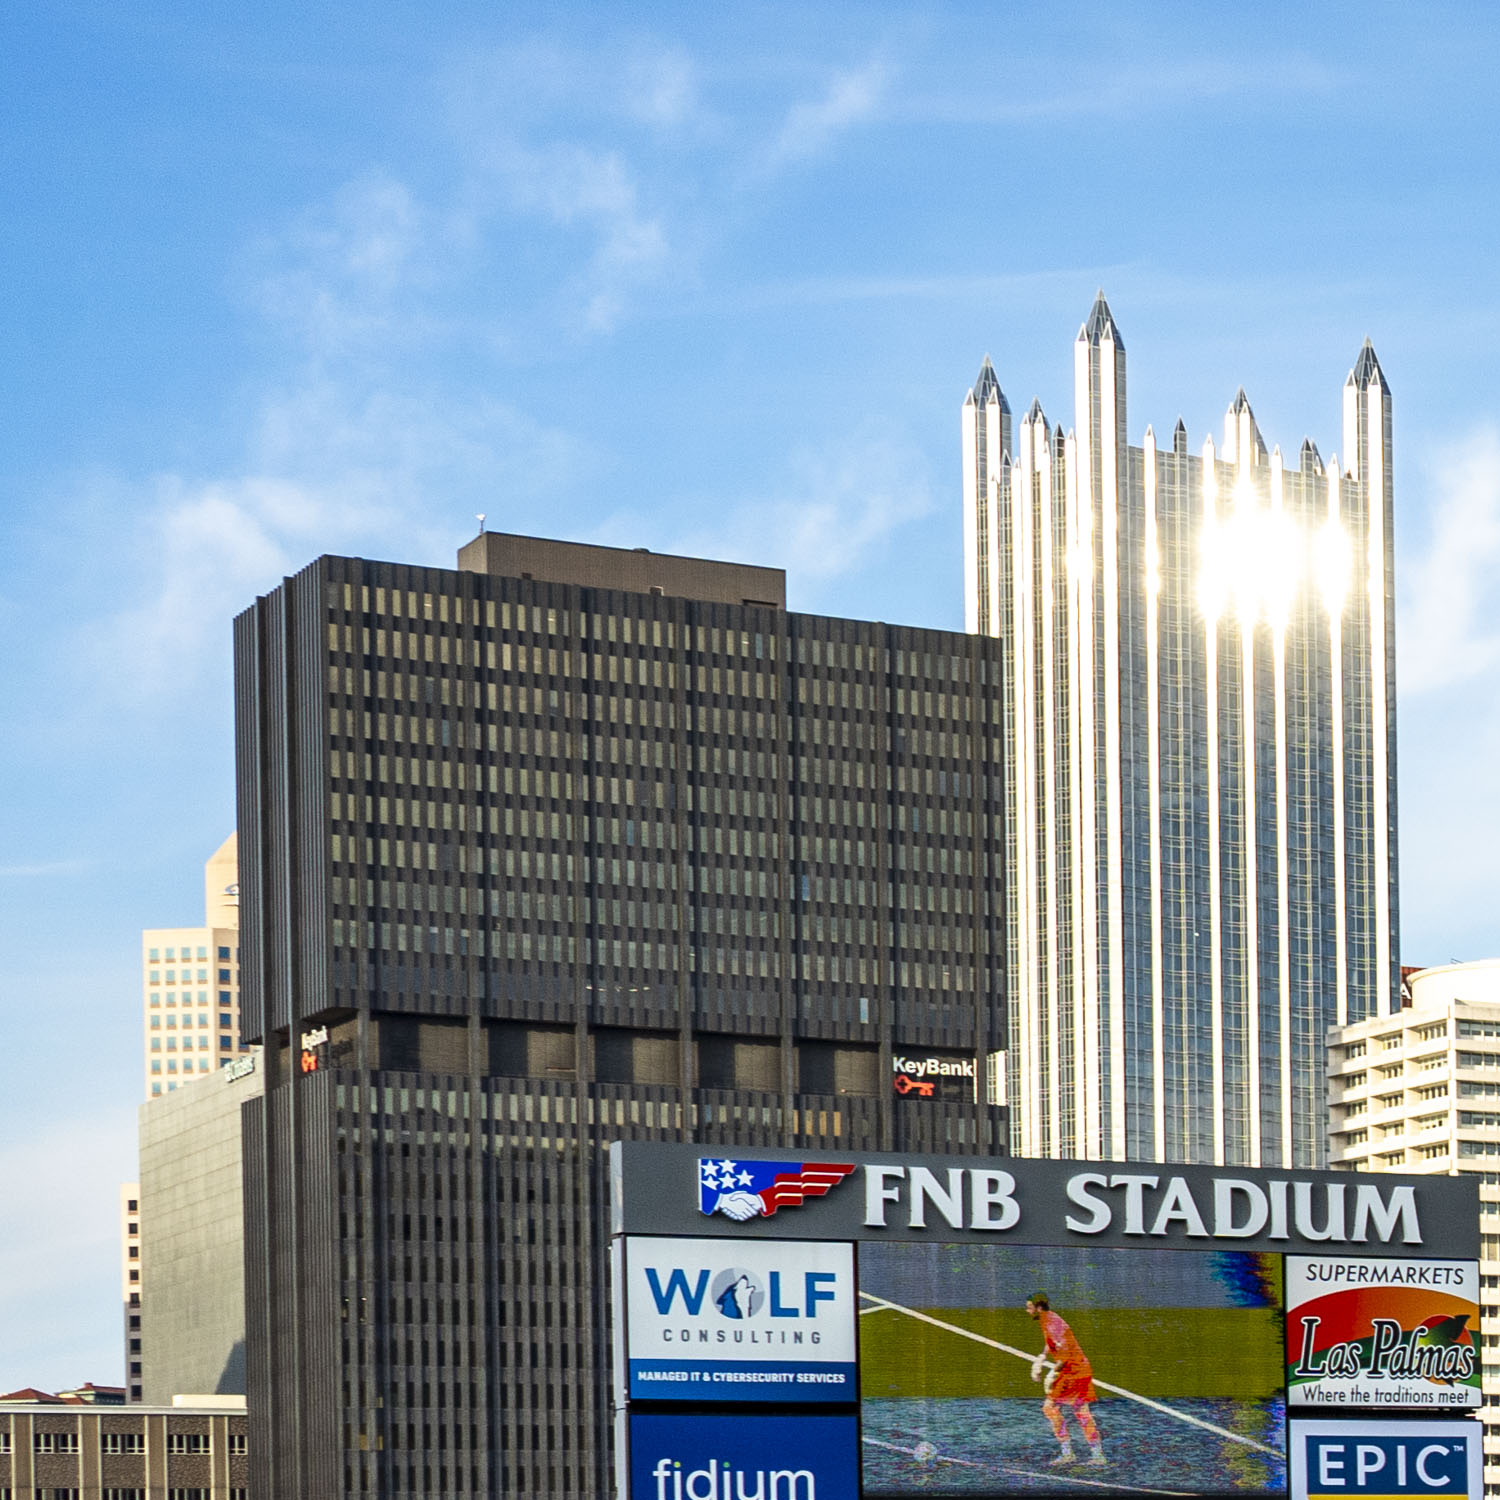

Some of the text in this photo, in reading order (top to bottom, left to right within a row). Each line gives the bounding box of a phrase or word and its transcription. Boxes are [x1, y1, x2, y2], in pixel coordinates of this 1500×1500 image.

[893, 1057, 974, 1077] KeyBank
[863, 1164, 1424, 1244] FNB STADIUM
[1306, 1263, 1465, 1285] SUPERMARKETS
[663, 1328, 822, 1345] CONSULTING
[1296, 1315, 1476, 1380] Las Palmas
[638, 1371, 846, 1384] MANAGED IT & CYBERSECURITY SERVICES
[1303, 1385, 1470, 1403] Where the traditions meet
[1318, 1444, 1451, 1487] EPIC
